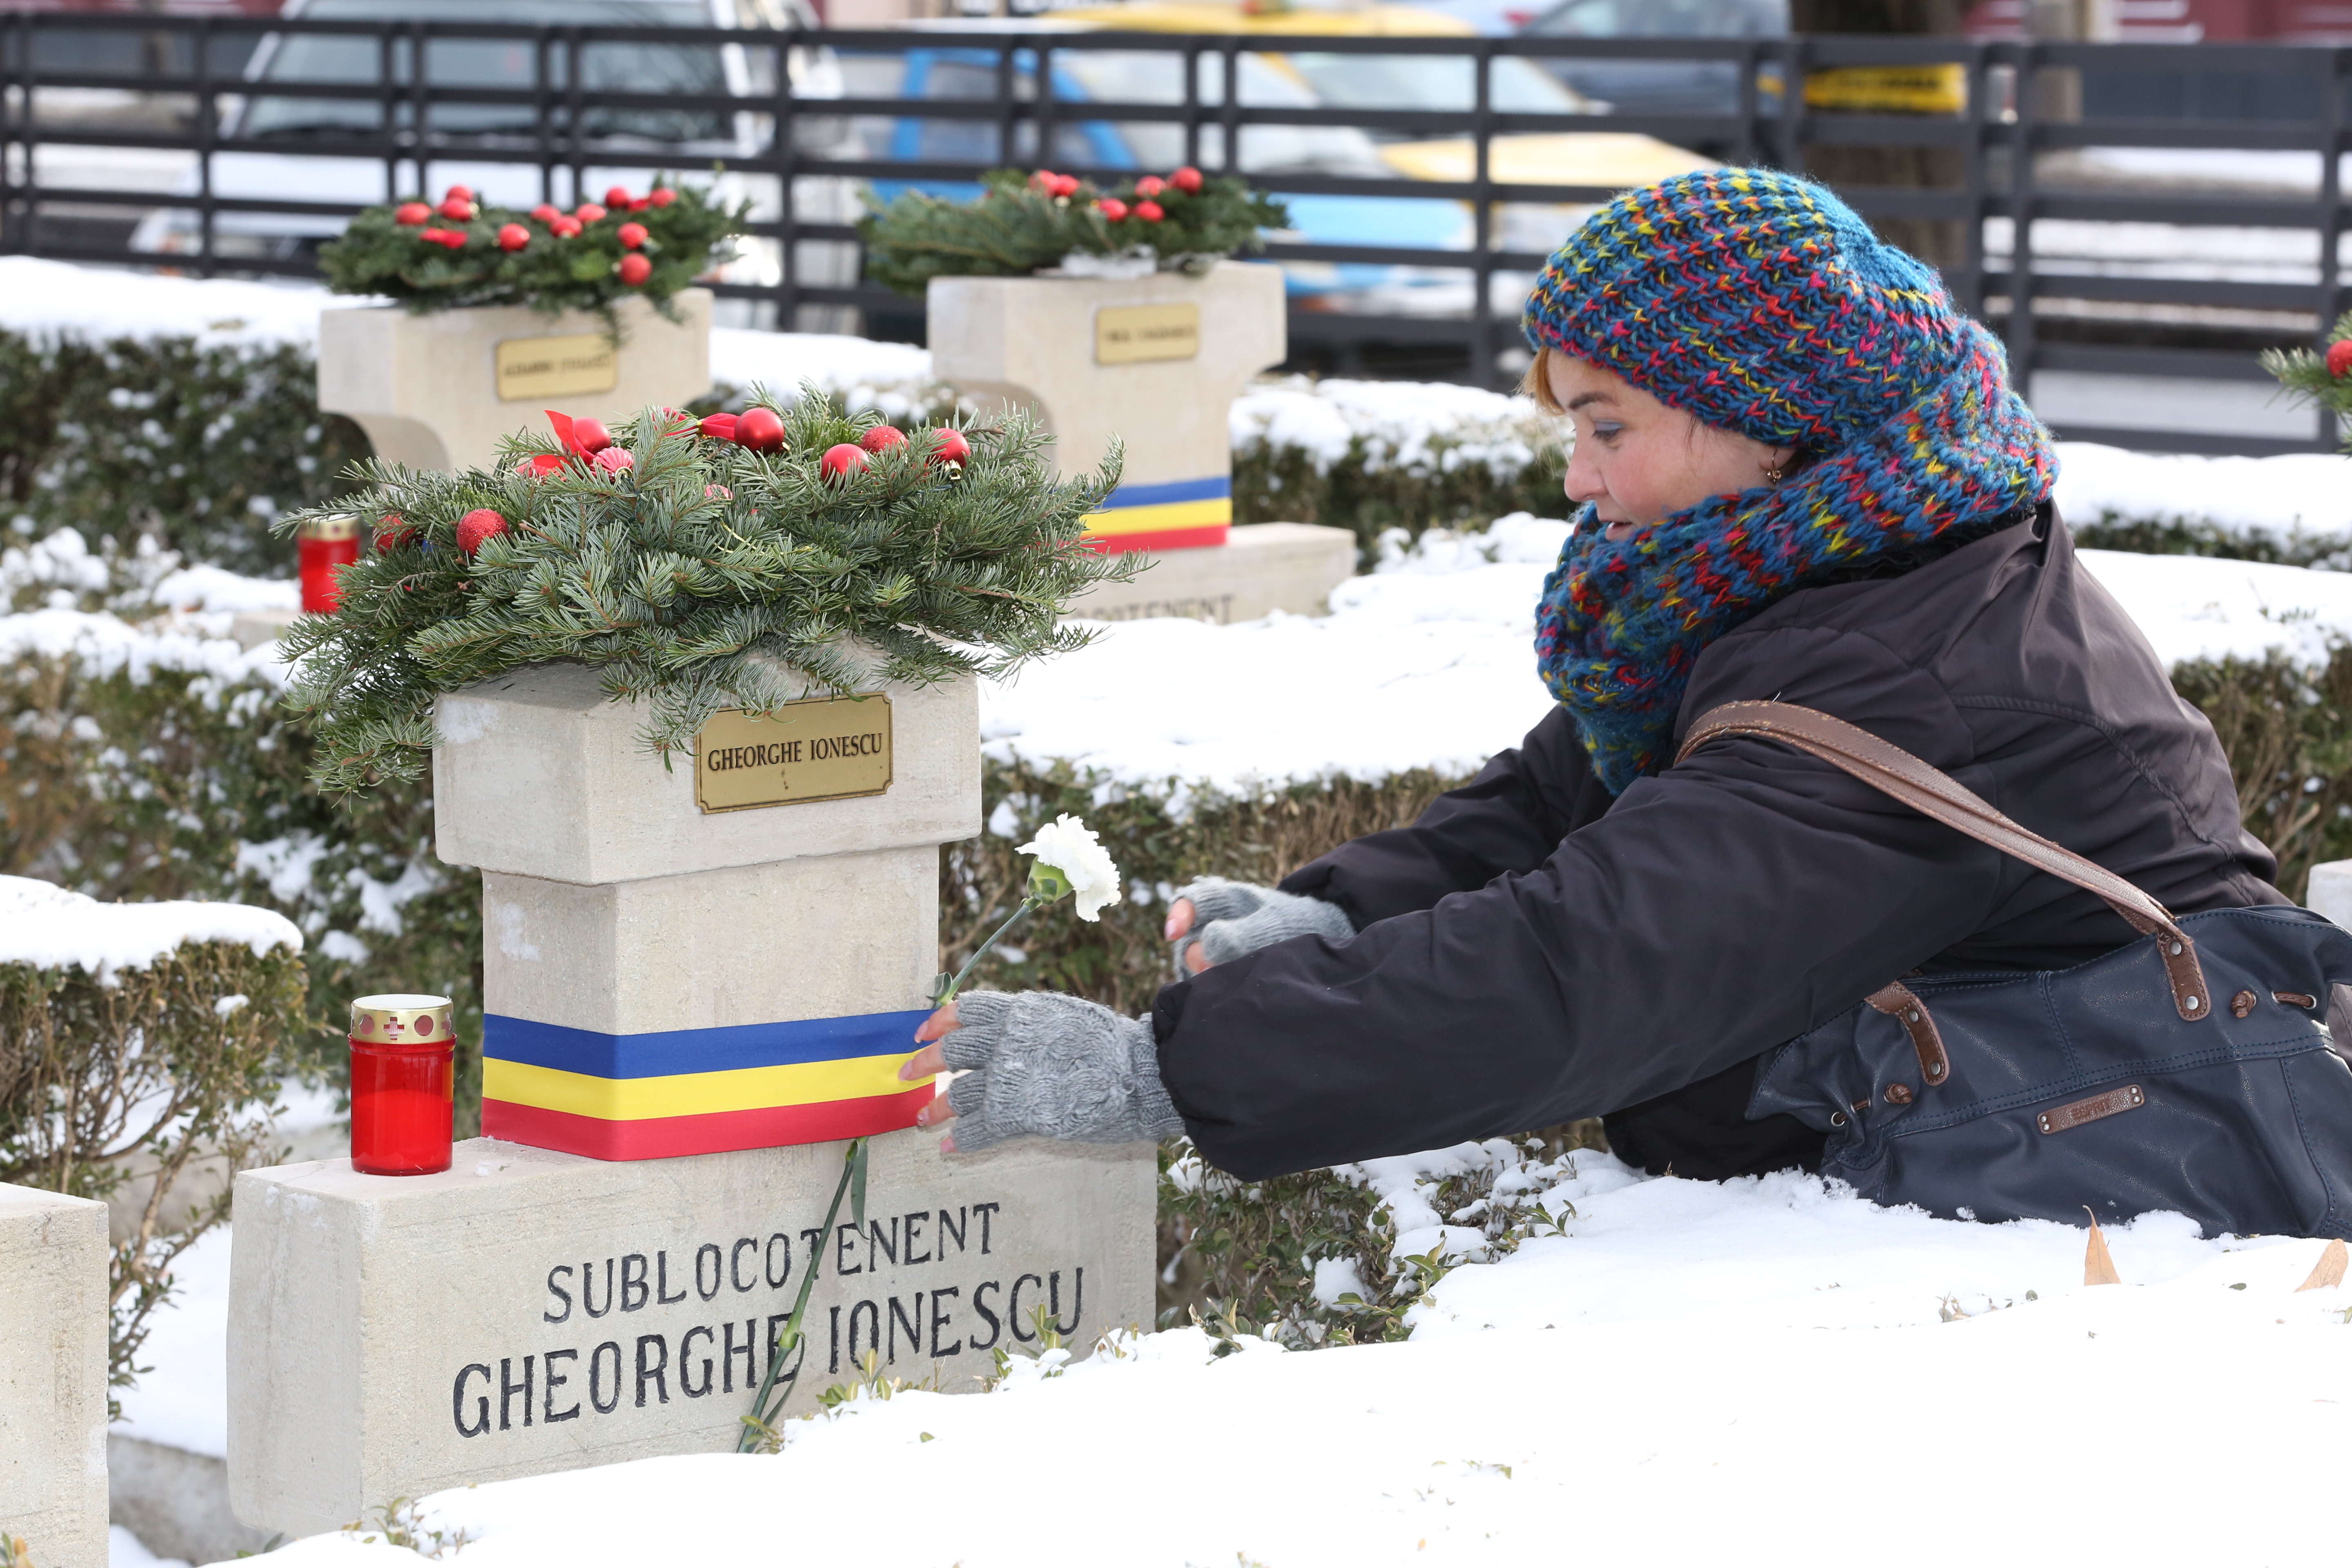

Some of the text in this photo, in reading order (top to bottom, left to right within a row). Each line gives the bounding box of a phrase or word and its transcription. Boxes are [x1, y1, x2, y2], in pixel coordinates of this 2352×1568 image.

[708, 733, 882, 771] GHEORGHE IONESCU
[2070, 1098, 2110, 1120] ESPRIT
[452, 1267, 1084, 1438] GHEORGHE IONESCU
